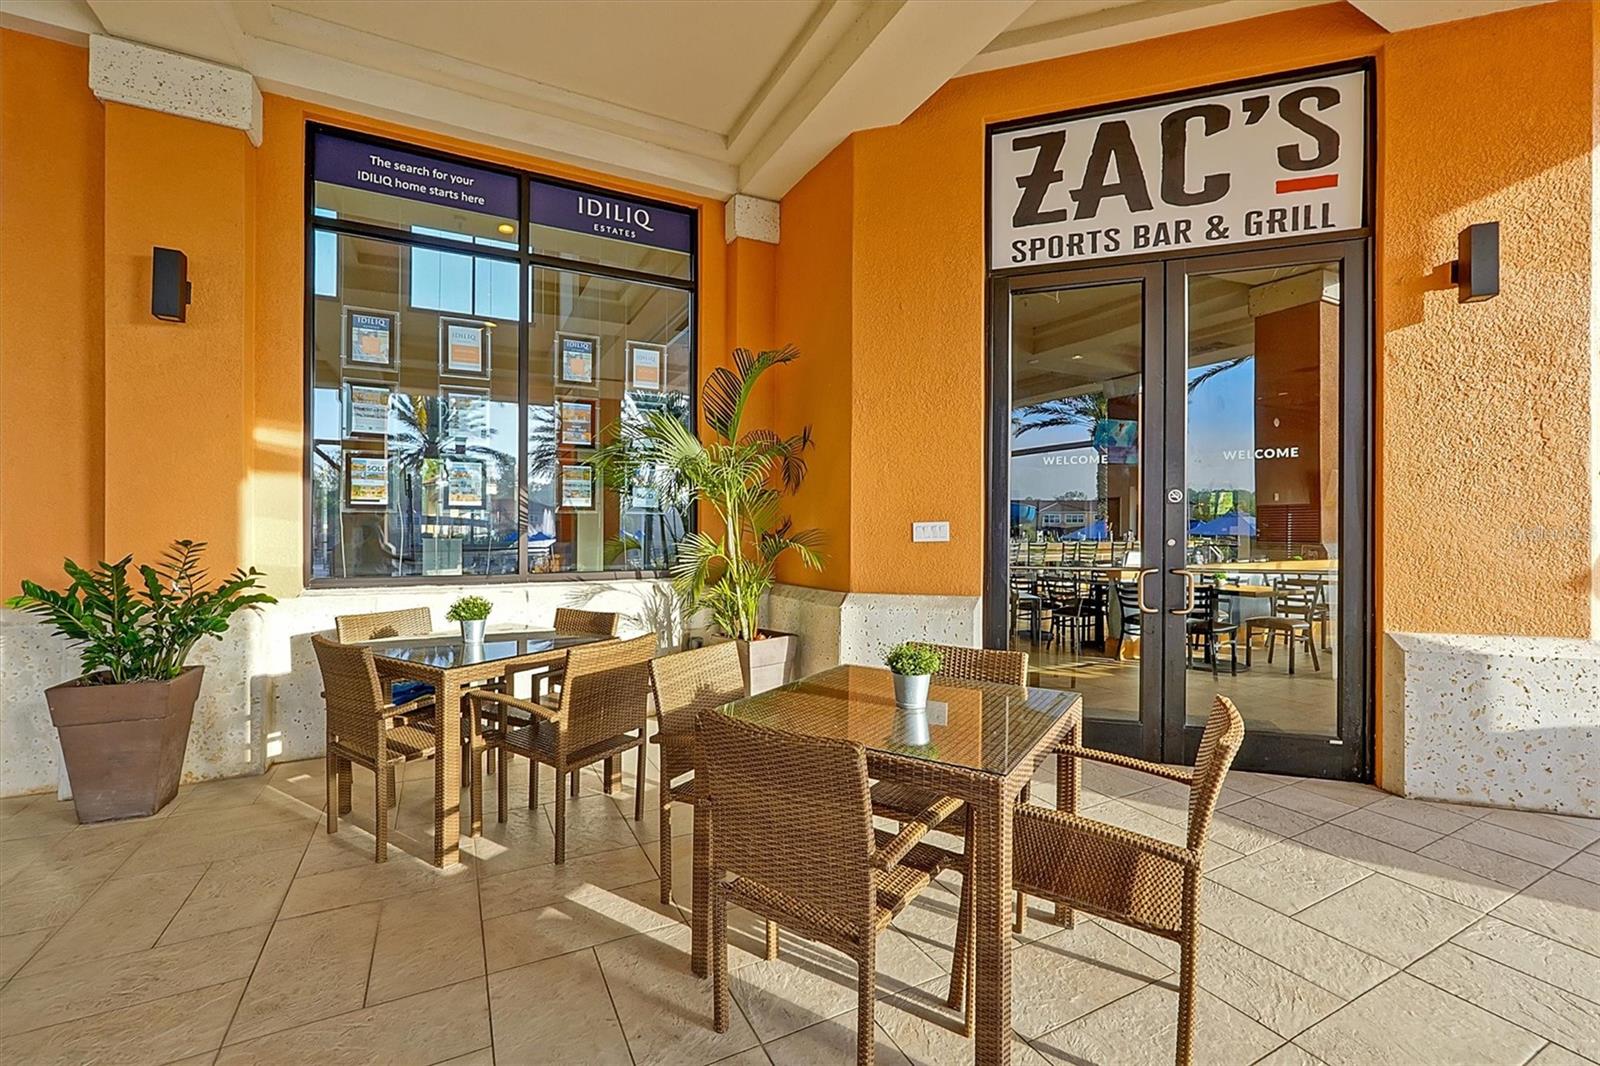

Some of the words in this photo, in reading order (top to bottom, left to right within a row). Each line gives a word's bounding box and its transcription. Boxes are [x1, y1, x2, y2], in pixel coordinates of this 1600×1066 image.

[1012, 86, 1341, 228] ZAC'S
[370, 155, 391, 168] The
[394, 161, 429, 177] search
[433, 168, 448, 180] for
[450, 175, 474, 186] your
[357, 170, 393, 188] IDILIQ
[395, 178, 426, 193] home
[429, 186, 459, 200] starts
[461, 191, 485, 205] here
[578, 196, 654, 232] IDILIQ
[593, 223, 636, 239] ESTATES
[1011, 226, 1121, 263] SPORTS
[1133, 218, 1192, 250] BAR
[1206, 214, 1229, 241] &
[1245, 202, 1336, 236] GRILL
[357, 316, 386, 327] IDILIQ
[566, 341, 589, 350] IDILIQ
[1043, 454, 1109, 466] WELCOME
[1223, 447, 1299, 461] WELCOME
